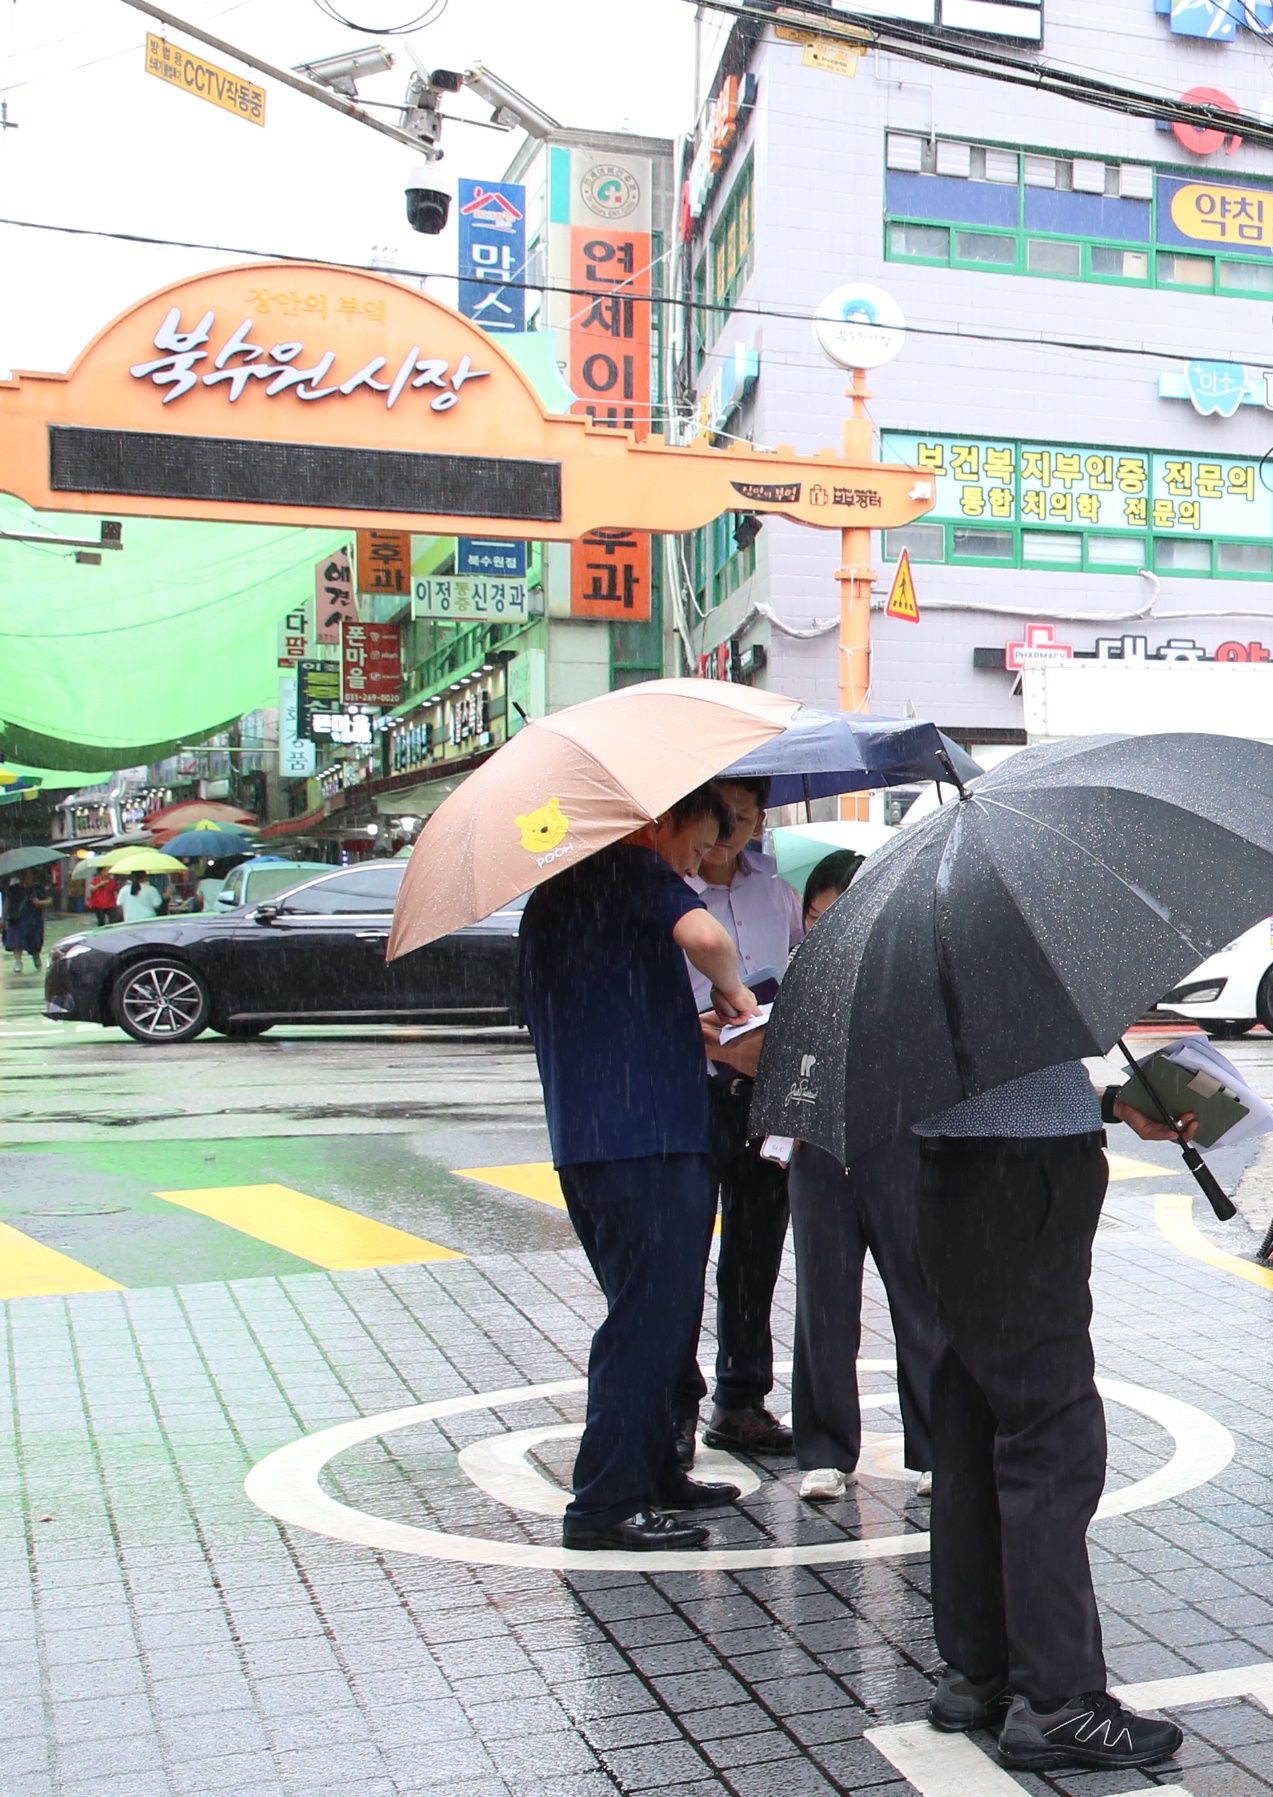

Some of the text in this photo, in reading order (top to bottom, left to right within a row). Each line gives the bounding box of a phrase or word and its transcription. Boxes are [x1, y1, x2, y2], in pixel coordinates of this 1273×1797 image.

[183, 59, 263, 118] CCTV작동중
[1195, 192, 1264, 240] 약침
[247, 288, 328, 319] 장안의
[130, 306, 492, 411] 북수원시장
[1201, 370, 1243, 396] 미소
[917, 442, 1256, 502] 보건복지부인증 전문의
[959, 485, 1201, 531] 통합치의학 전문의
[369, 532, 404, 591] 후과
[468, 555, 518, 570] 북수원점
[345, 625, 368, 690] 폰마을
[536, 841, 575, 869] POOH
